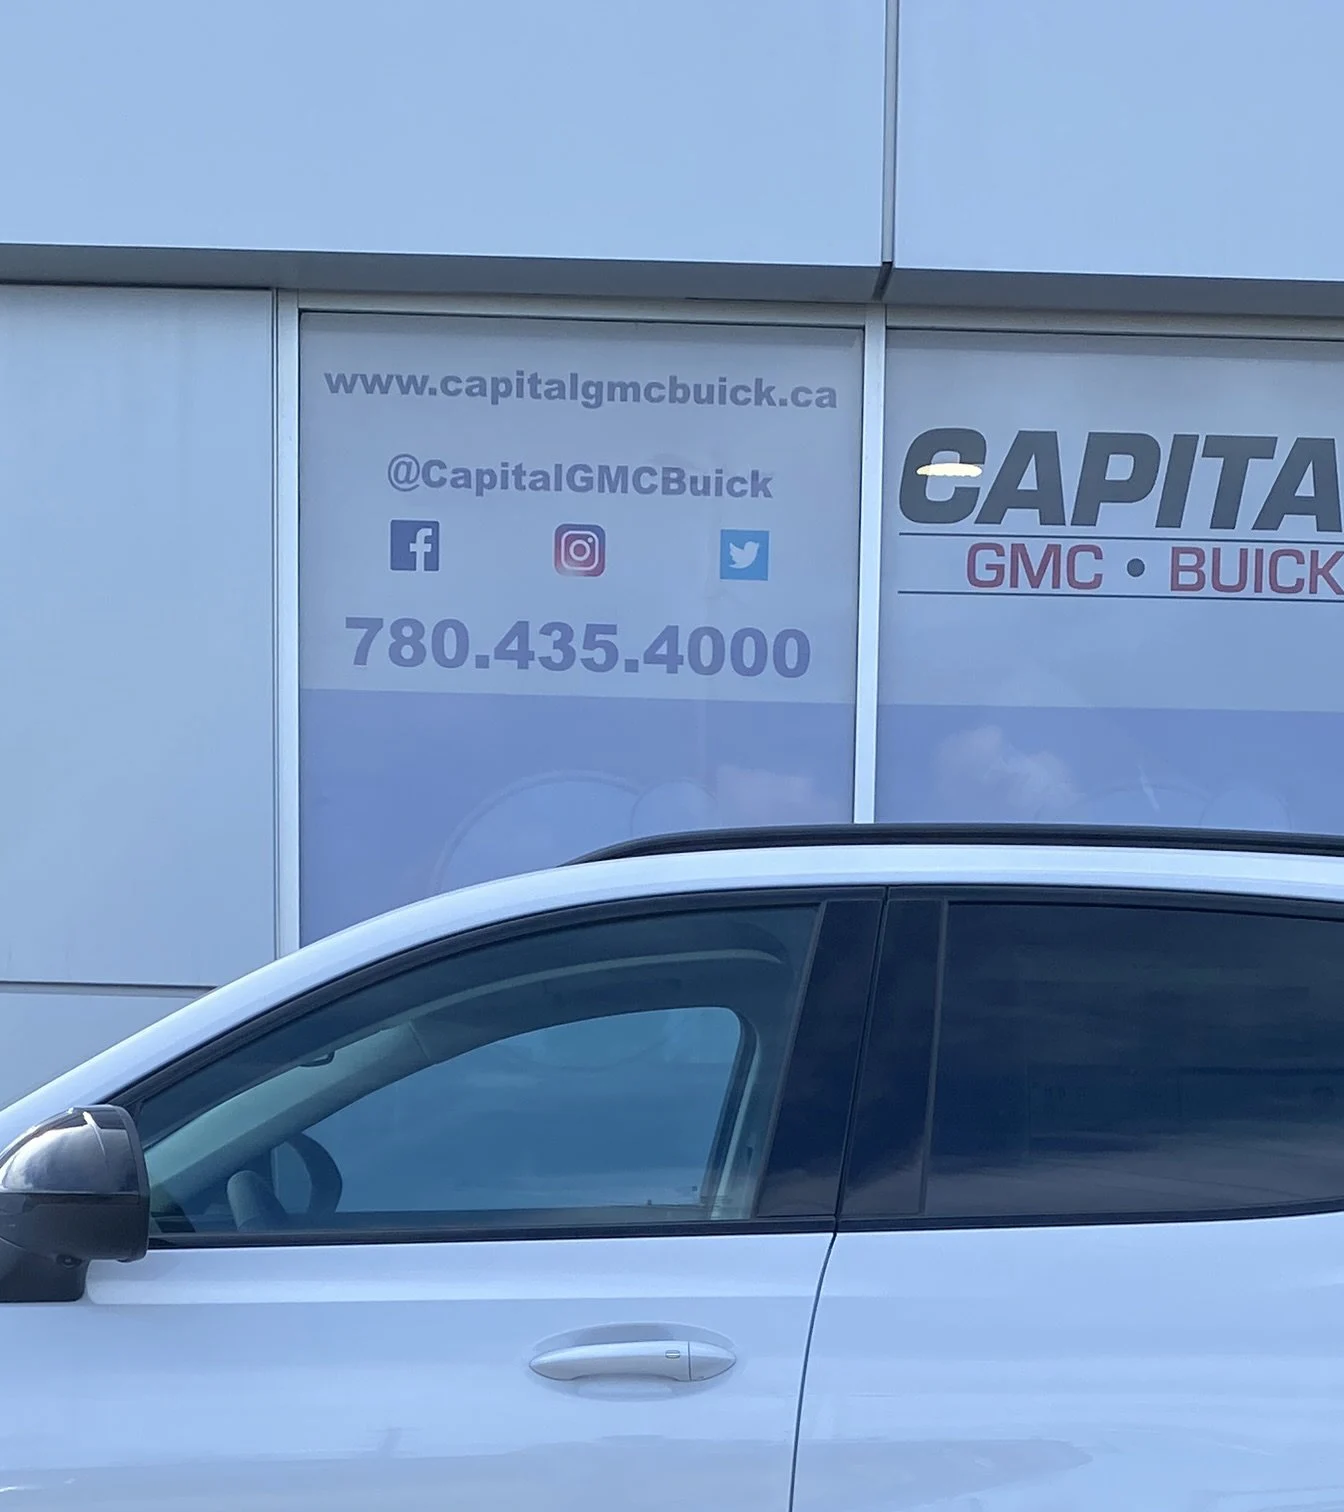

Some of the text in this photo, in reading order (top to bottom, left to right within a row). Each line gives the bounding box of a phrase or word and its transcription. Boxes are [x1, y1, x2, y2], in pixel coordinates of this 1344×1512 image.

[324, 370, 838, 409] www.capitalgmcbuick.ca
[387, 454, 773, 498] @CapitalGMCBuick
[966, 543, 1103, 590] GMC
[345, 617, 811, 678] 780.435.4000
